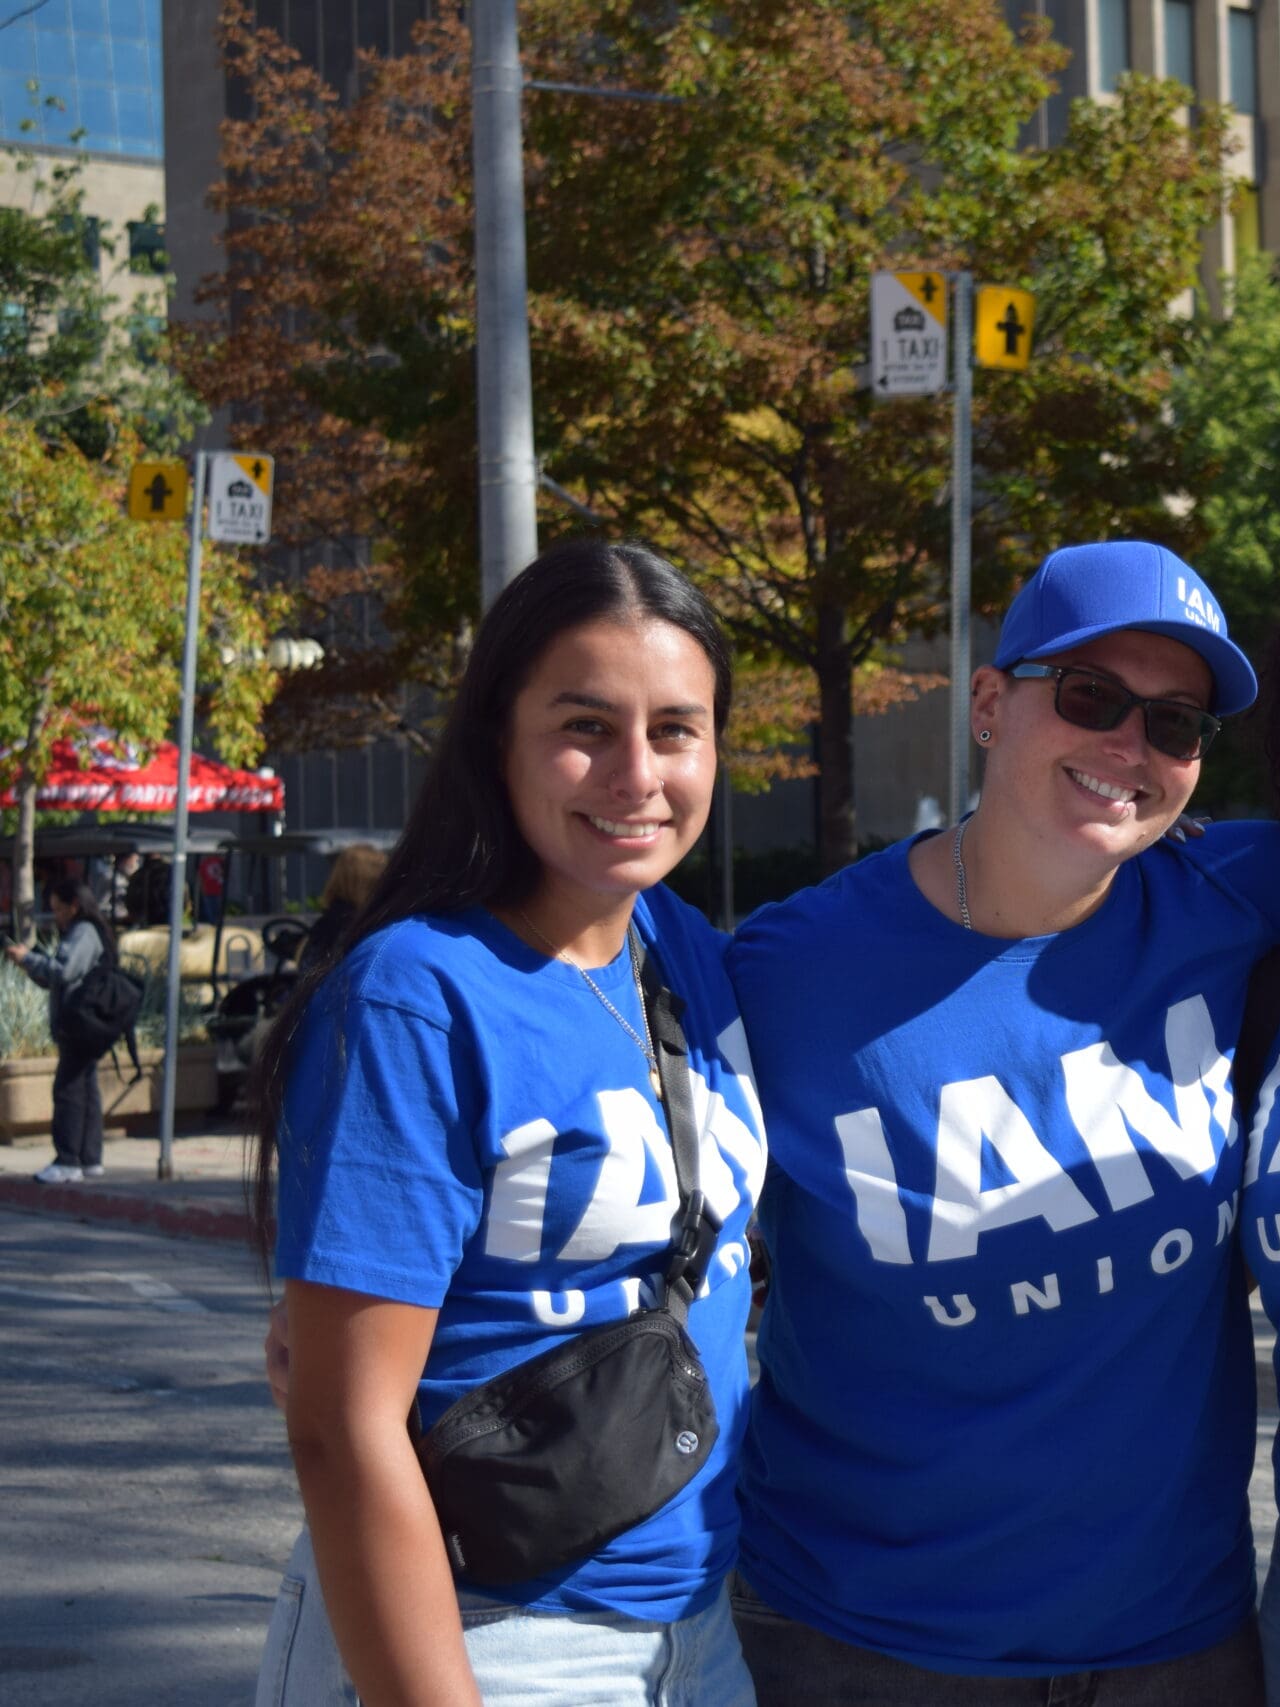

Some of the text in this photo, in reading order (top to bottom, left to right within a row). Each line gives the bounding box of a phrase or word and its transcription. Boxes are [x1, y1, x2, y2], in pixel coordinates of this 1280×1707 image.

[898, 338, 939, 360] TAXI
[230, 502, 263, 519] TAXI
[1178, 577, 1220, 633] IAM
[834, 994, 1238, 1265] IAM
[924, 1191, 1239, 1327] UNION
